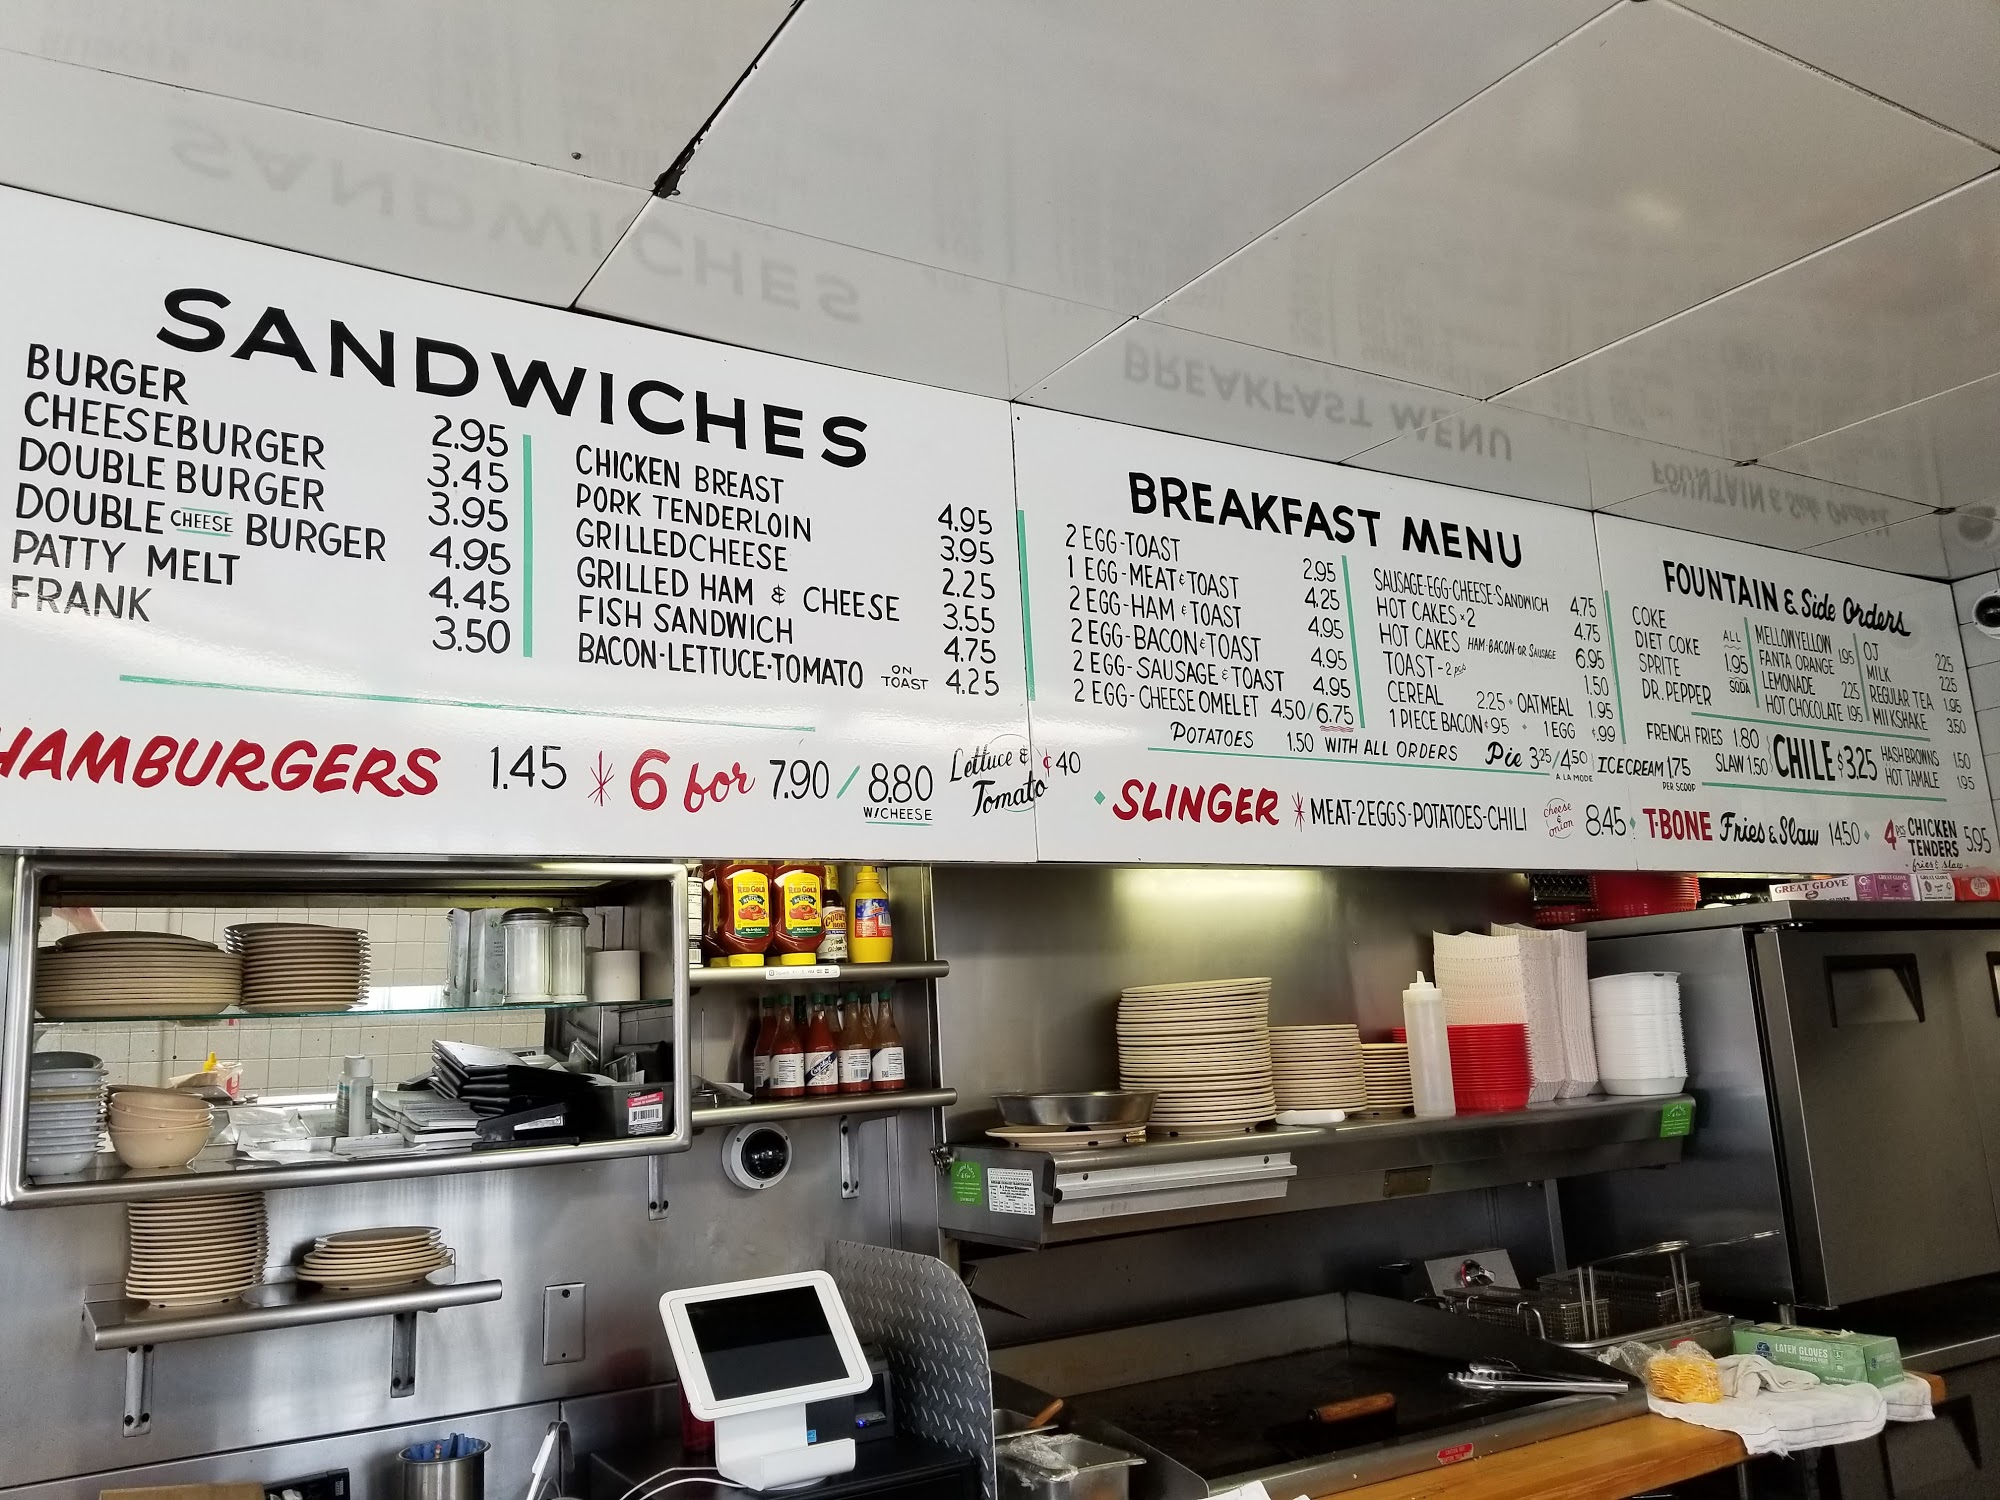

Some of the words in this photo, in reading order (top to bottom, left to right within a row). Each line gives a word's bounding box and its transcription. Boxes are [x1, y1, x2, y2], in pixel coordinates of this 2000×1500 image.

[27, 343, 189, 405] BURGER
[156, 288, 868, 468] SANDWICHES
[24, 391, 326, 470] CHEESEBURGER
[432, 414, 509, 456] 2.95
[19, 437, 166, 490] DOUBLE
[176, 461, 325, 512] BURGER
[427, 453, 509, 493] 3.45
[576, 443, 680, 490] CHICKEN
[694, 465, 785, 505] BREAST
[15, 482, 166, 535] DOUBLE
[170, 509, 233, 533] CHEESE
[246, 514, 387, 562] BURGER
[428, 492, 509, 532] 3.95
[577, 483, 642, 516] PORK
[653, 495, 811, 542] TENDERLOIN
[938, 504, 993, 535] 4.95
[1128, 472, 1380, 547] BREAKFAST
[1402, 516, 1522, 568] MENU
[940, 536, 995, 565] 3.95
[1065, 524, 1077, 548] 2
[12, 529, 126, 573] PATTY
[148, 545, 241, 586] MELT
[429, 535, 511, 575] 4.95
[1302, 558, 1336, 582] 2.95
[577, 556, 689, 598] GRILLED
[700, 572, 753, 606] HAM
[771, 584, 787, 606] &
[803, 585, 900, 622] CHEESE
[941, 568, 995, 600] 2.25
[1067, 554, 1074, 578] 1
[1187, 571, 1239, 600] TOAST
[10, 574, 152, 622] FRANK
[428, 575, 511, 613] 4.45
[1069, 586, 1081, 611] 2
[1189, 601, 1241, 629] TOAST
[1304, 587, 1341, 611] 4.25
[1569, 596, 1597, 618] 4.75
[1663, 560, 1779, 612] FOUNTAIN
[1784, 588, 1798, 615] &
[1801, 588, 1836, 621] Side
[1843, 596, 1911, 636] Orders
[578, 595, 642, 628] FISH
[653, 603, 793, 645] SANDWICH
[942, 603, 996, 634] 3.55
[1071, 618, 1083, 644] 2
[1307, 616, 1344, 640] 4.95
[1377, 596, 1408, 620] HOT
[1411, 601, 1457, 626] CAKES
[1574, 622, 1601, 643] 4.75
[1632, 606, 1667, 629] COKE
[431, 615, 511, 654] 3.50
[943, 636, 997, 664] 4.75
[1379, 622, 1409, 647] HOT
[1415, 627, 1461, 653] CAKES
[1575, 647, 1605, 670] 6.95
[1635, 630, 1662, 650] DIET
[1669, 635, 1700, 655] COKE
[1723, 630, 1741, 642] ALL
[1311, 647, 1347, 671] 4.95
[1639, 653, 1681, 676] SPRITE
[1724, 653, 1748, 674] 1.95
[1759, 649, 1792, 669] FANTA
[1796, 654, 1834, 674] ORANGE
[1864, 642, 1878, 660] OJ
[880, 675, 929, 691] TOAST
[891, 664, 913, 676] ON
[945, 668, 999, 696] 4.25
[1073, 650, 1084, 672] 2
[1231, 666, 1284, 693] TOAST
[1383, 650, 1435, 679] TOAST
[1583, 675, 1609, 697] 1.50
[1762, 671, 1815, 695] LEMONADE
[1866, 664, 1891, 683] MILK
[1073, 678, 1085, 703] 2
[1199, 691, 1259, 718] OMELET
[1313, 676, 1351, 699] 4.95
[1387, 680, 1444, 706] CEREAL
[1476, 690, 1506, 711] 2.25
[1517, 692, 1574, 718] OATMEAL
[1588, 700, 1614, 721] 1.95
[1729, 680, 1751, 694] SODA
[1870, 685, 1910, 707] REGULAR
[1912, 691, 1934, 710] TEA
[1765, 694, 1785, 715] HOT
[1789, 697, 1844, 721] CHOCOLATE
[1872, 707, 1928, 730] MILKSHAKE
[1401, 708, 1438, 731] PIECE
[1441, 713, 1483, 734] BACON
[1551, 721, 1576, 739] EGG
[1646, 723, 1691, 742] FRENCH
[1695, 727, 1723, 745] FRIES
[1733, 727, 1759, 748] 1.80
[1170, 721, 1254, 749] POTATOES
[1286, 731, 1314, 752] 1.50
[1324, 736, 1357, 755] WITH
[1363, 739, 1389, 756] ALL
[1396, 741, 1458, 761] ORDERS
[1485, 741, 1523, 768] Pie
[949, 744, 1013, 783] Lettuce
[1667, 755, 1692, 779] 1.75
[1716, 753, 1743, 773] SLAW
[1747, 755, 1768, 775] 1.50
[1773, 734, 1836, 781] CHILE
[490, 745, 567, 789] 1.45
[630, 748, 671, 811] 6
[683, 761, 756, 813] for
[769, 759, 830, 800] 7.90
[868, 763, 934, 803] 8.80
[972, 770, 1049, 817] Tomato
[1573, 774, 1593, 783] MODE
[1675, 782, 1696, 792] SCOOP
[1885, 767, 1903, 786] HOT
[1905, 769, 1940, 789] TAMALE
[864, 807, 933, 820] W/CHEESE
[1112, 778, 1280, 826] SLINGER
[1543, 802, 1572, 818] cheese
[1549, 820, 1574, 837] onion
[1585, 804, 1627, 836] 8.45
[1719, 811, 1766, 844] Fries
[1769, 825, 1778, 844] &
[1779, 815, 1819, 846] Slaw
[1828, 821, 1861, 846] 14.50
[1884, 818, 1896, 850] 4
[1908, 817, 1958, 838] CHICKEN
[1908, 839, 1959, 857] TENDERS
[1964, 826, 1991, 853] 5.95
[737, 886, 750, 894] RED
[788, 886, 801, 894] RED
[1775, 884, 1809, 895] GREAT
[1812, 879, 1848, 890] GLOVE
[1799, 1346, 1828, 1358] GLOVES
